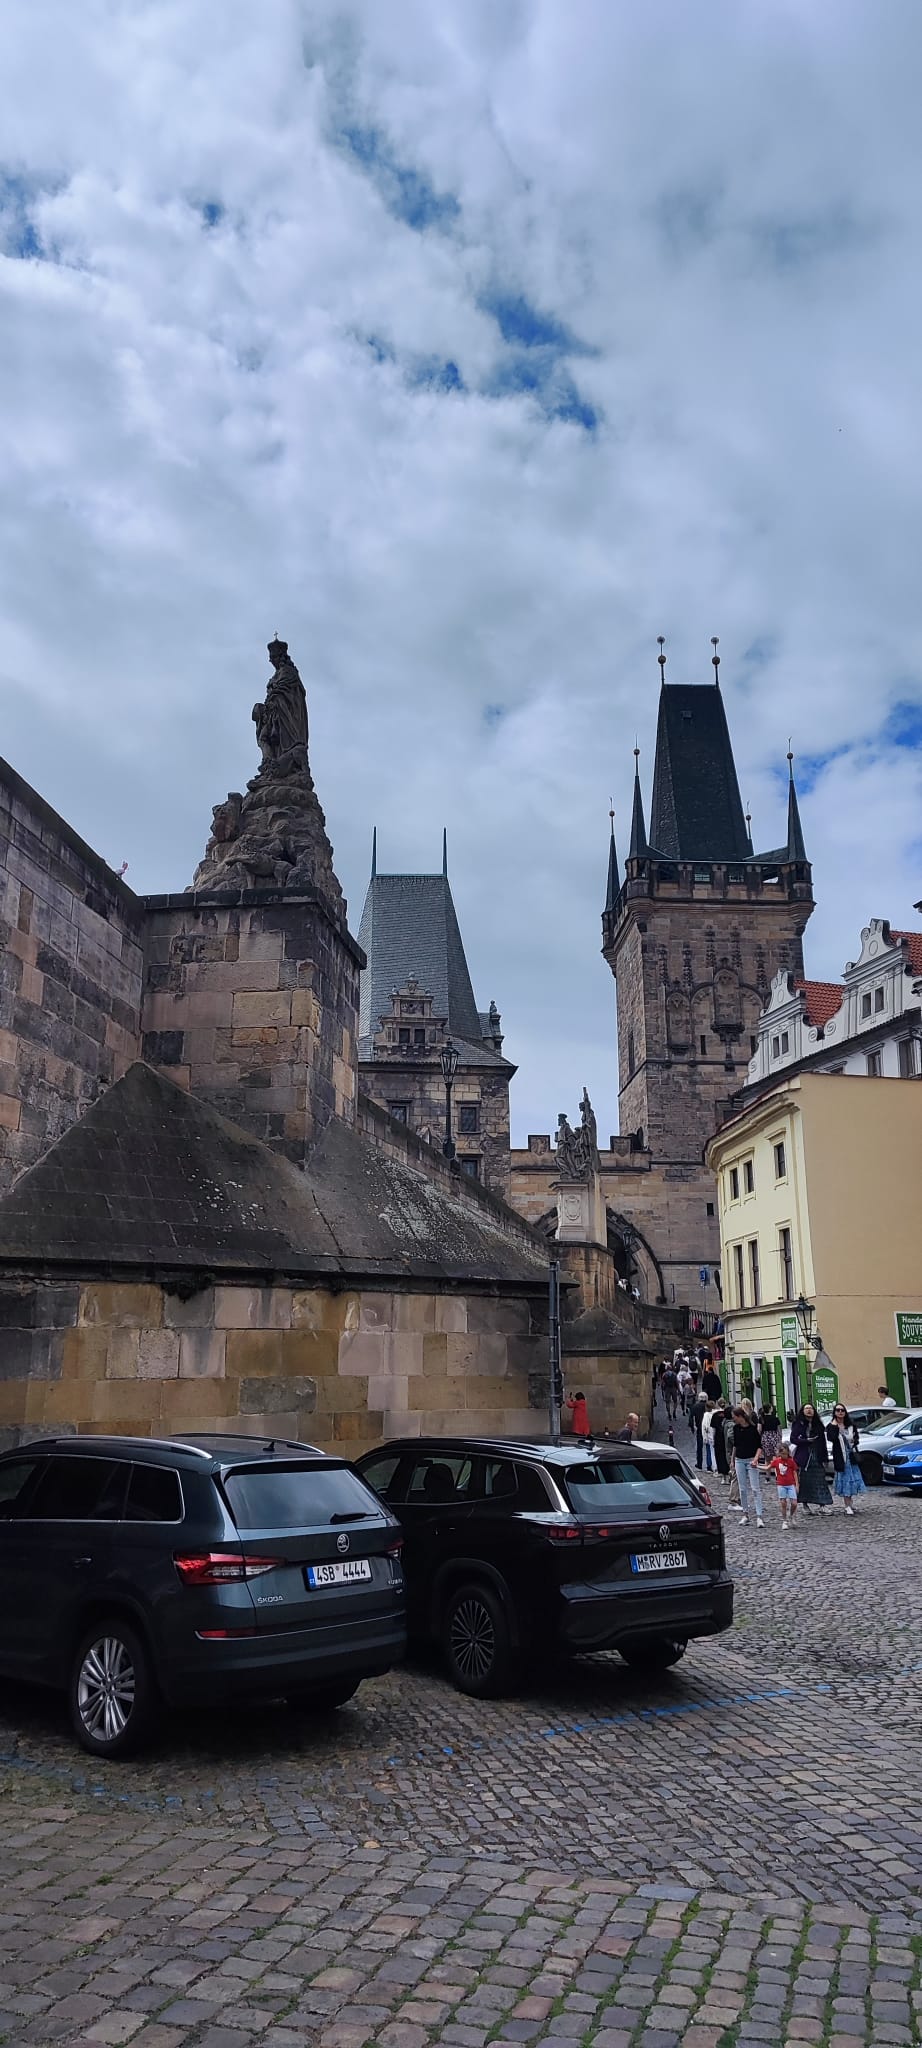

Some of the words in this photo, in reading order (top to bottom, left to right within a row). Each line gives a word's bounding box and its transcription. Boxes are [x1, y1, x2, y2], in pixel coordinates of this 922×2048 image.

[815, 1375, 834, 1383] Unique
[637, 1556, 645, 1570] M
[649, 1554, 661, 1568] RV
[663, 1552, 685, 1568] 2867
[316, 1566, 336, 1583] 4SB
[342, 1561, 366, 1579] 4444
